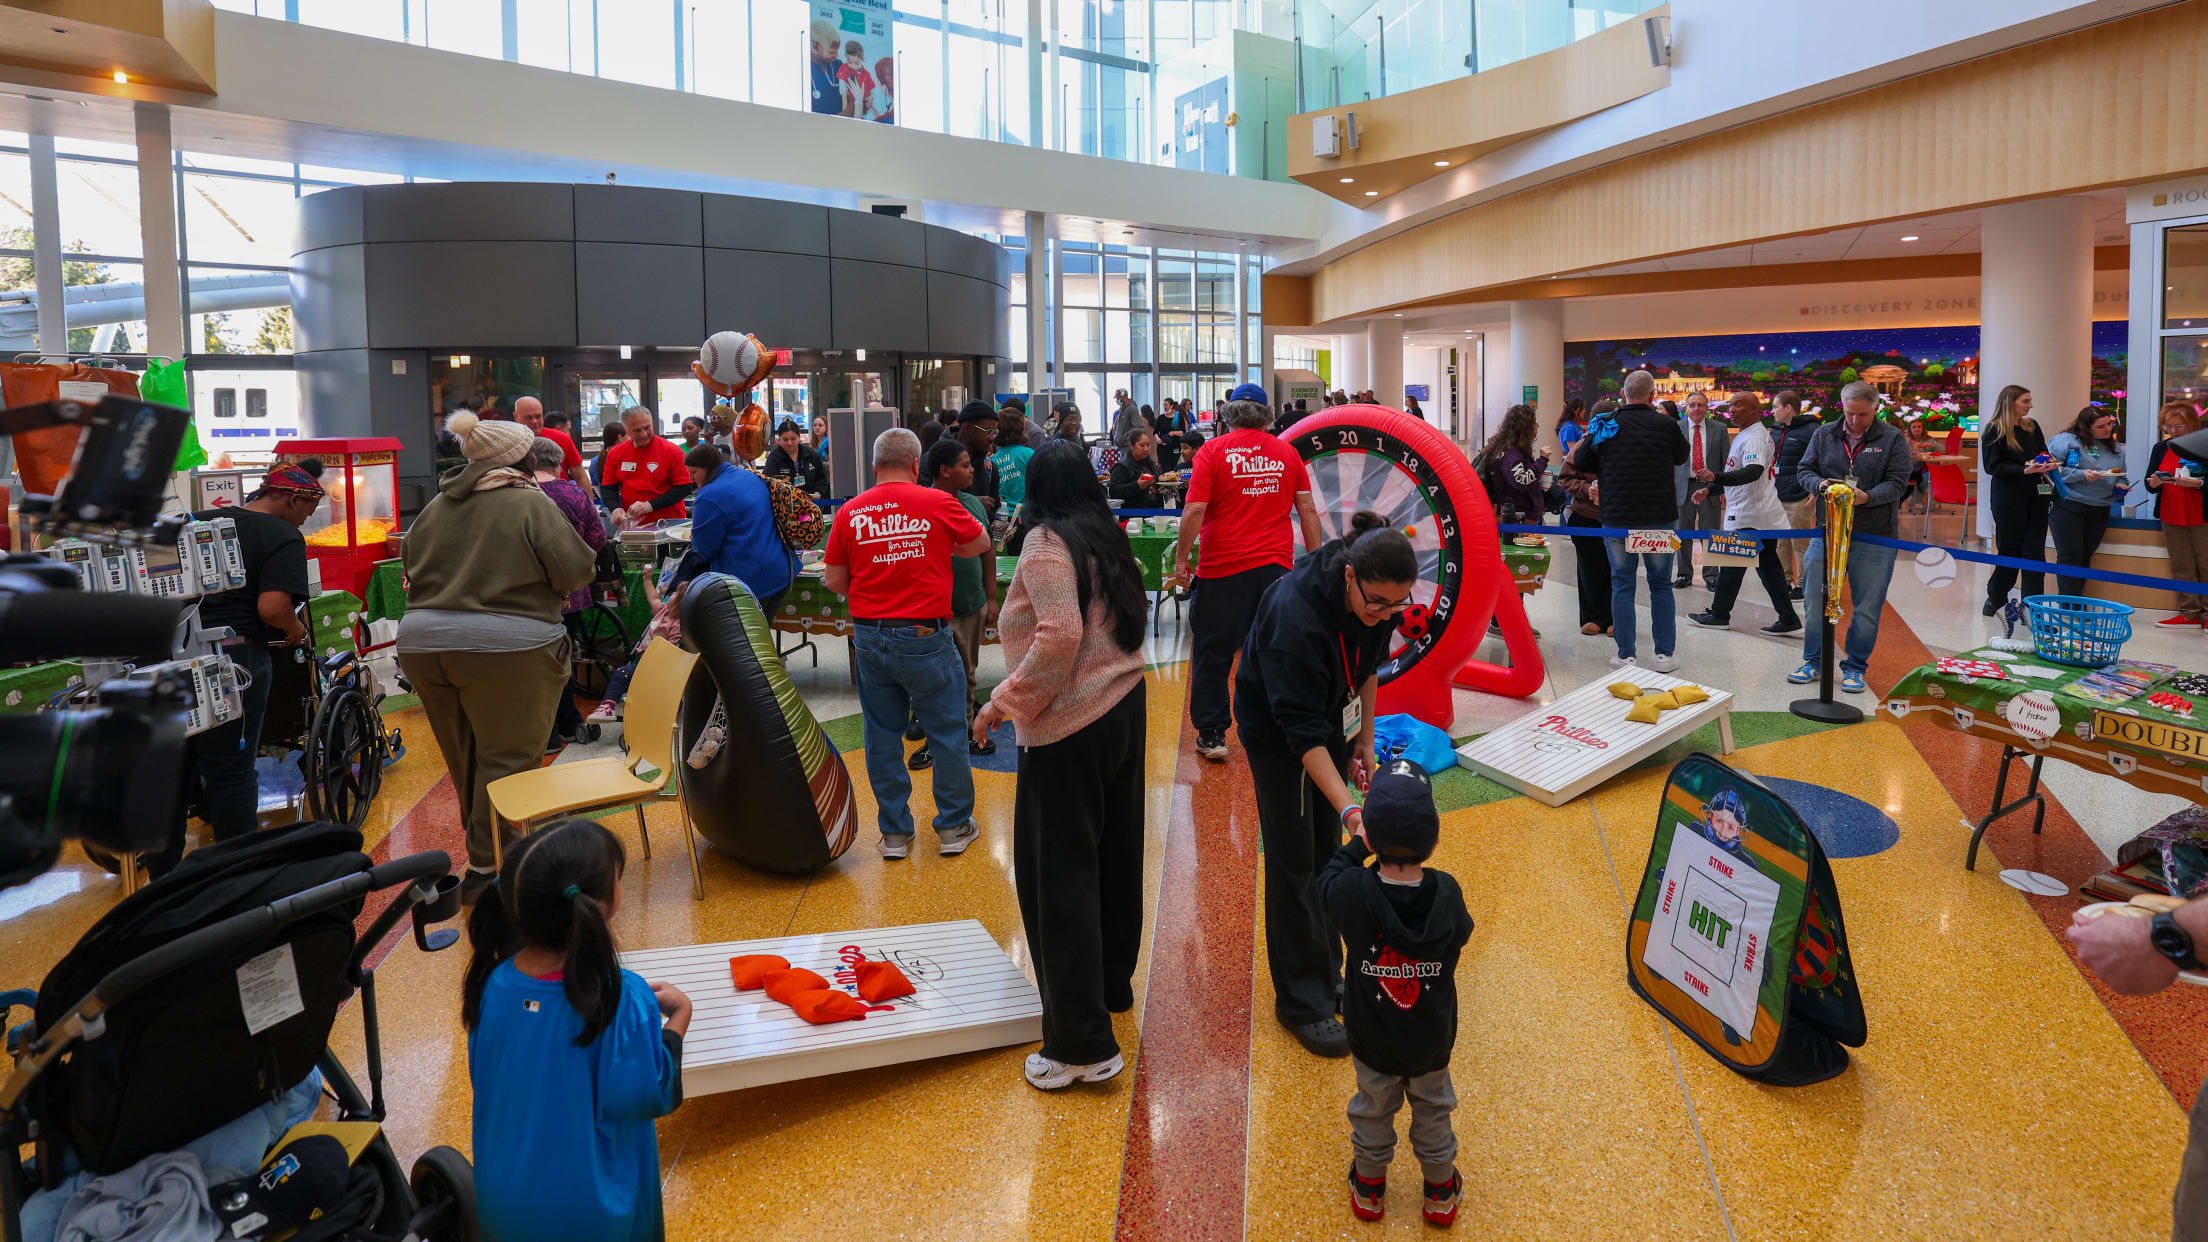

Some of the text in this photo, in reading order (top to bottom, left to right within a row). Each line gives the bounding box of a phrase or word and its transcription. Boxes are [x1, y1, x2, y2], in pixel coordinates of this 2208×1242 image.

[868, 0, 888, 10] Best
[1811, 298, 1977, 316] DISCOVERY ZONE
[1311, 435, 1323, 450] 5
[1339, 431, 1359, 446] 20
[1376, 438, 1385, 453] 1
[361, 454, 391, 462] POPCORN
[1226, 453, 1285, 474] Phillies
[1401, 451, 1419, 473] 18
[1511, 462, 1537, 485] World
[206, 481, 235, 491] Exit
[1242, 484, 1280, 498] support!
[1253, 478, 1264, 487] for
[1428, 484, 1439, 498] 4
[849, 501, 900, 516] thanking the
[849, 513, 931, 540] Phillies
[1440, 514, 1455, 539] 13
[888, 540, 924, 552] for their
[1631, 536, 1670, 550] Team
[1712, 535, 1757, 547] Welcome
[872, 546, 925, 565] support!
[1445, 561, 1457, 574] 6
[1435, 595, 1451, 621] 10
[1414, 632, 1432, 654] 15
[1391, 658, 1400, 675] 2
[2026, 711, 2049, 722] ticket
[1537, 715, 1609, 750] Phillies
[1708, 855, 1735, 880] STRIKE
[1662, 879, 1677, 915] STRIKE
[1689, 900, 1733, 950] HIT
[1743, 933, 1758, 973] STRIKE
[1361, 960, 1442, 979] Aaron is TOF
[1684, 970, 1710, 998] STRIKE
